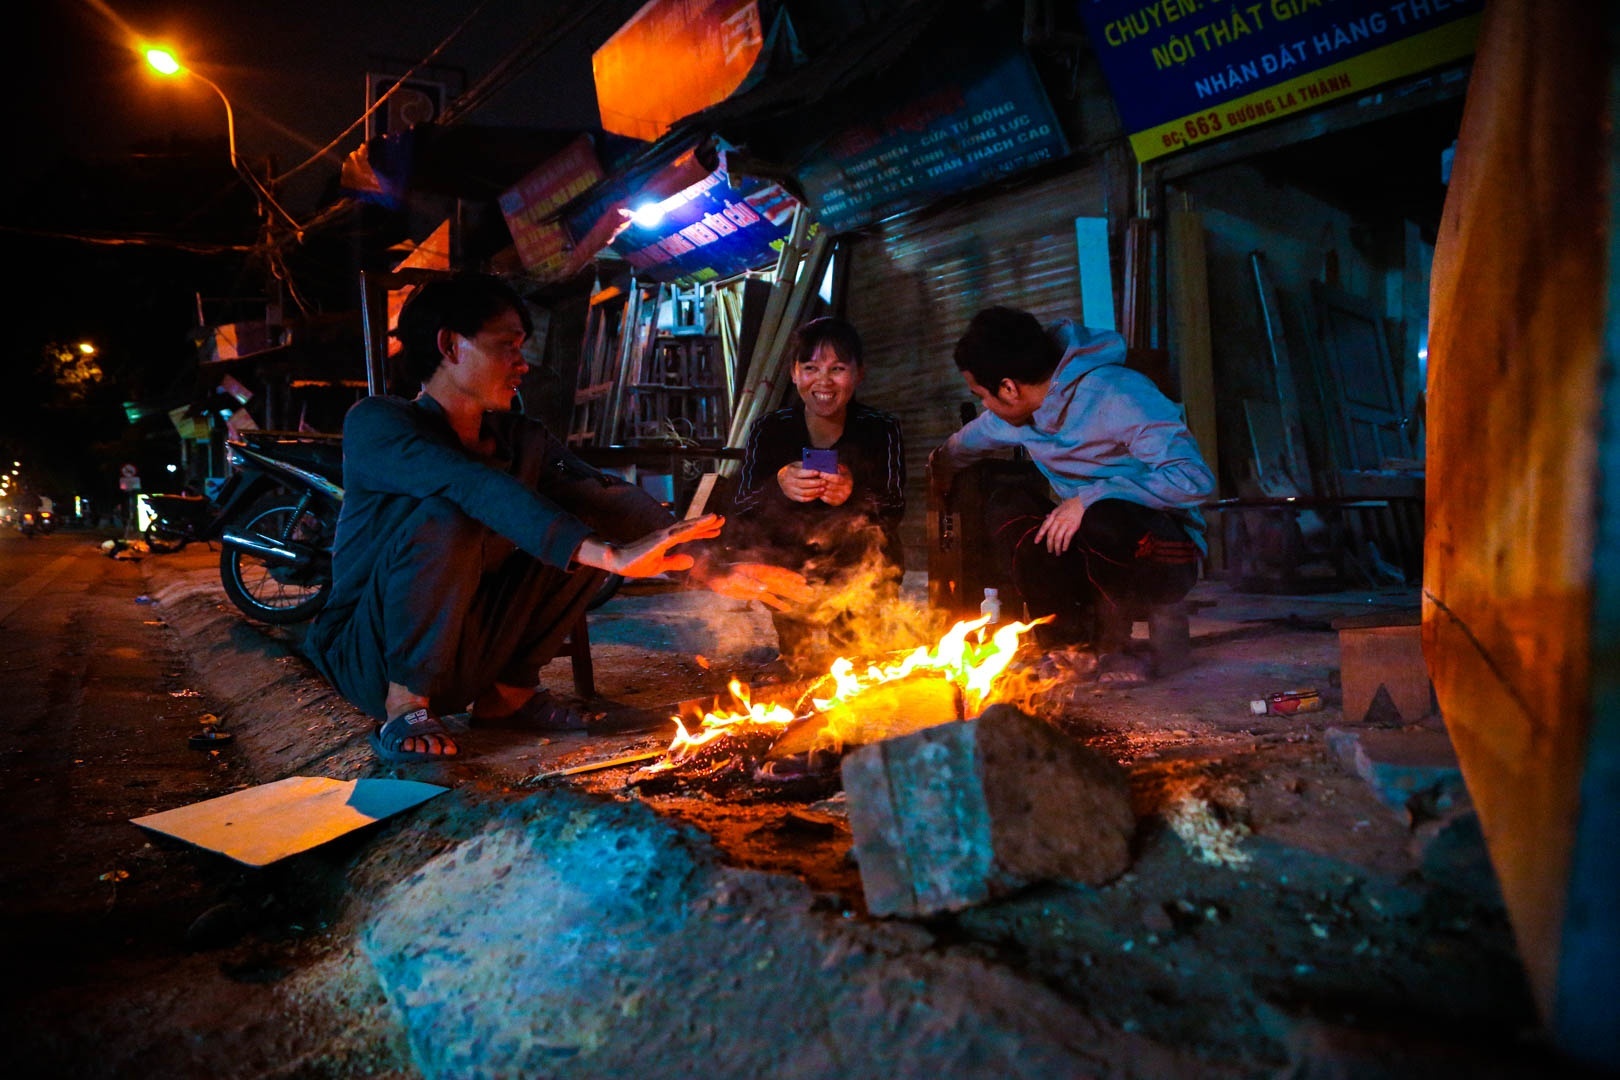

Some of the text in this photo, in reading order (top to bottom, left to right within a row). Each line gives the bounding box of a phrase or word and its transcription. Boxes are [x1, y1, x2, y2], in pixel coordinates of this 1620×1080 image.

[1151, 34, 1196, 70] NỘI
[1195, 3, 1264, 52] THẤT
[1194, 0, 1466, 99] NHẬN ĐẶT HÀNG THE
[1016, 123, 1051, 144] CAO
[1184, 112, 1222, 139] 663
[1277, 93, 1297, 110] LA
[1298, 73, 1351, 102] THÀNH
